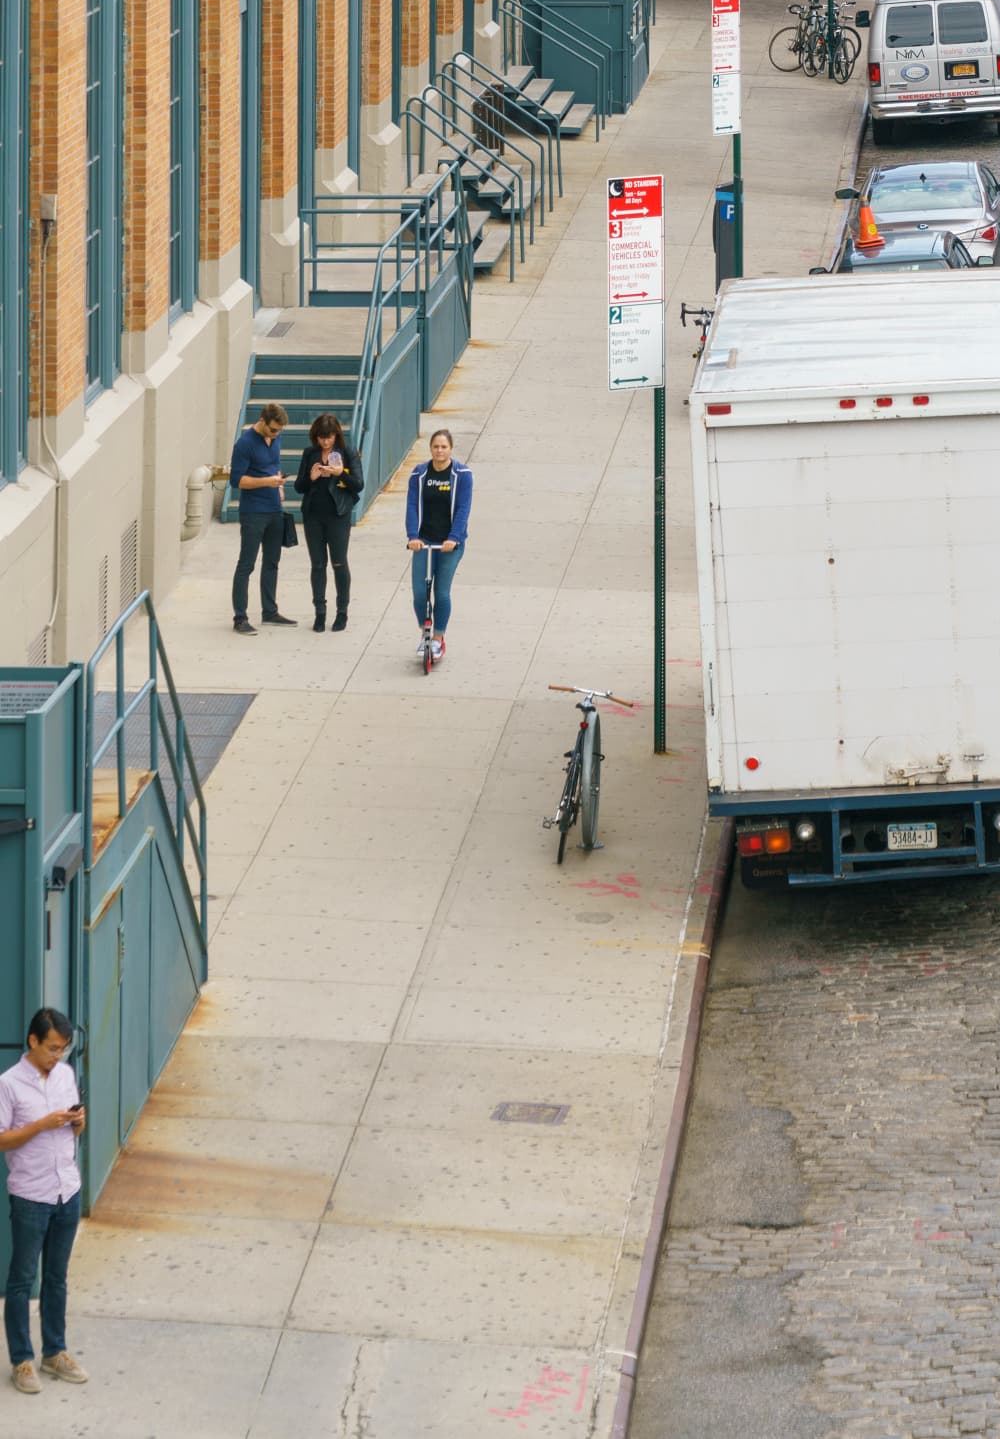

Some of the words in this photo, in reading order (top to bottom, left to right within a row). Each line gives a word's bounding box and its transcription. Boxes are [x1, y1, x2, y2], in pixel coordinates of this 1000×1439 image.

[713, 15, 719, 27] 3
[714, 75, 719, 88] 2
[634, 179, 659, 188] STANDING
[611, 222, 620, 238] 3
[611, 240, 652, 251] COMMERCIAL
[611, 251, 640, 260] VEHICLES
[611, 307, 620, 323] 2
